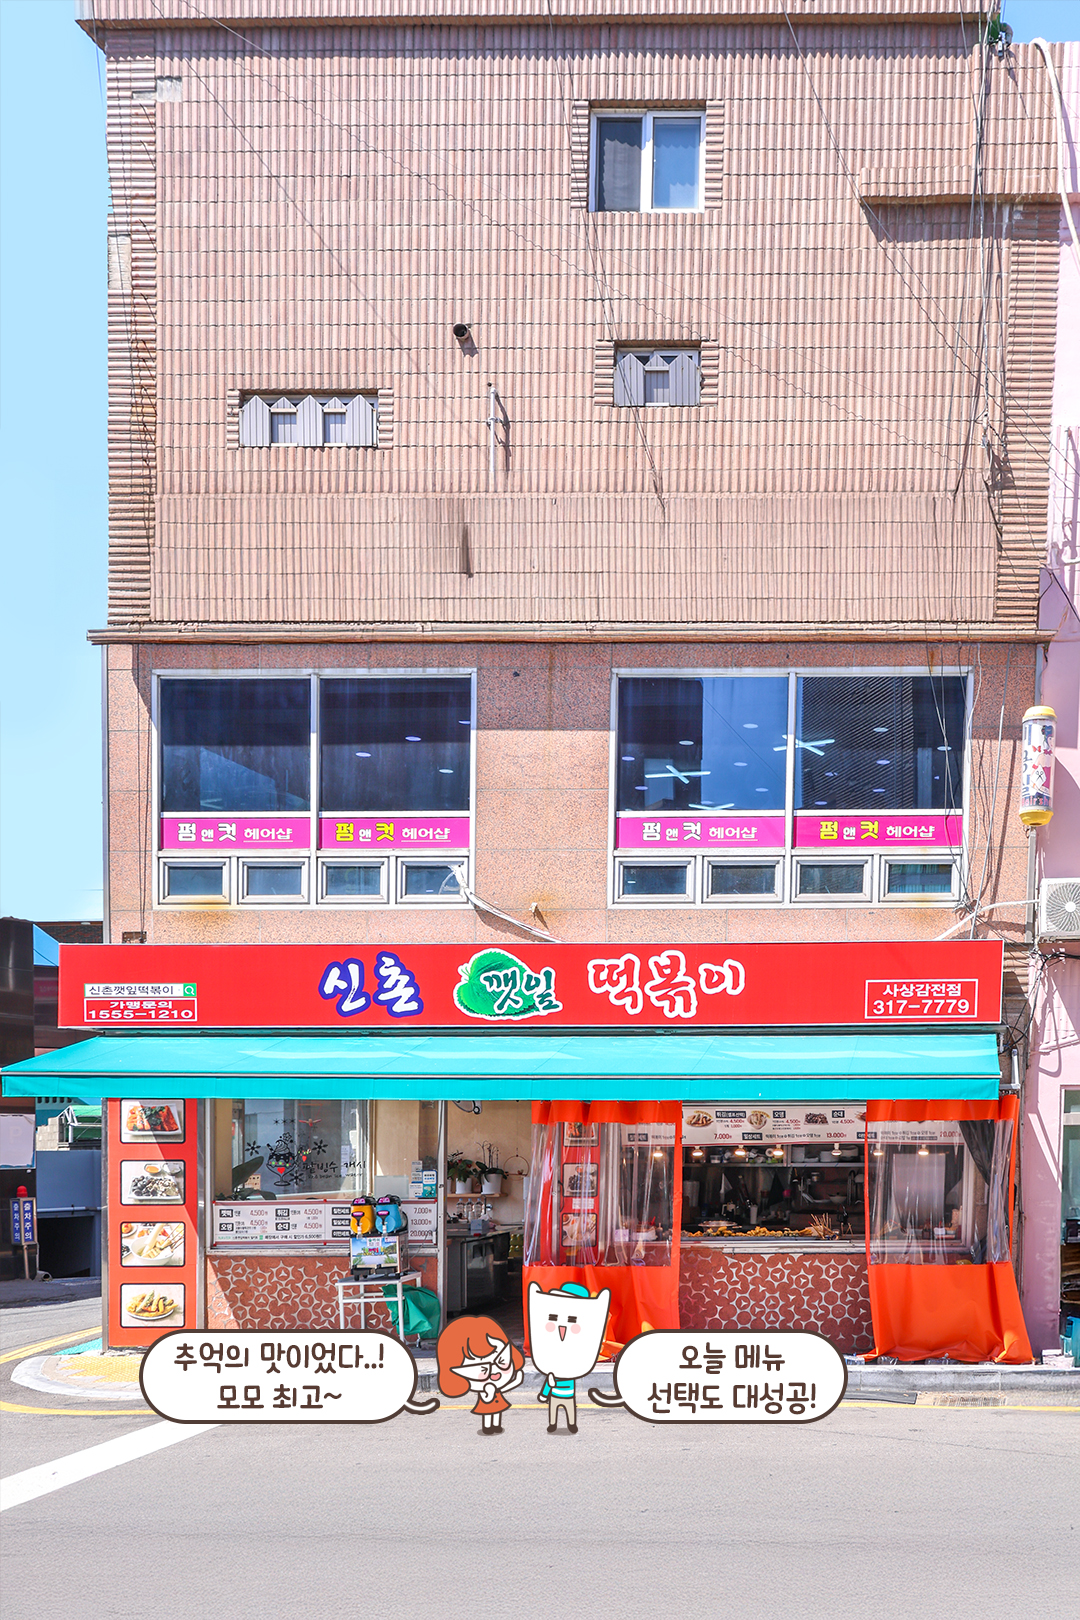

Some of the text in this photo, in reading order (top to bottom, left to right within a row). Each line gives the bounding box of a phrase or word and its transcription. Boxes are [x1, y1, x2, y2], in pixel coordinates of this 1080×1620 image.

[243, 827, 293, 840] 헤어샵
[401, 827, 451, 840] 헤어샵
[708, 826, 757, 839] 헤어샵
[886, 825, 935, 839] 헤어샵
[88, 984, 174, 996] 신촌깻잎떡볶이
[320, 952, 423, 1017] 신촌
[590, 952, 743, 1016] 떡볶이
[882, 983, 962, 998] 사상감전점
[109, 1000, 173, 1010] 가맹문의
[872, 999, 970, 1015] 317-7779
[88, 1009, 193, 1020] 1555-1210
[302, 1160, 366, 1174] 팥빙수 개시
[24, 1202, 32, 1240] 출차주의
